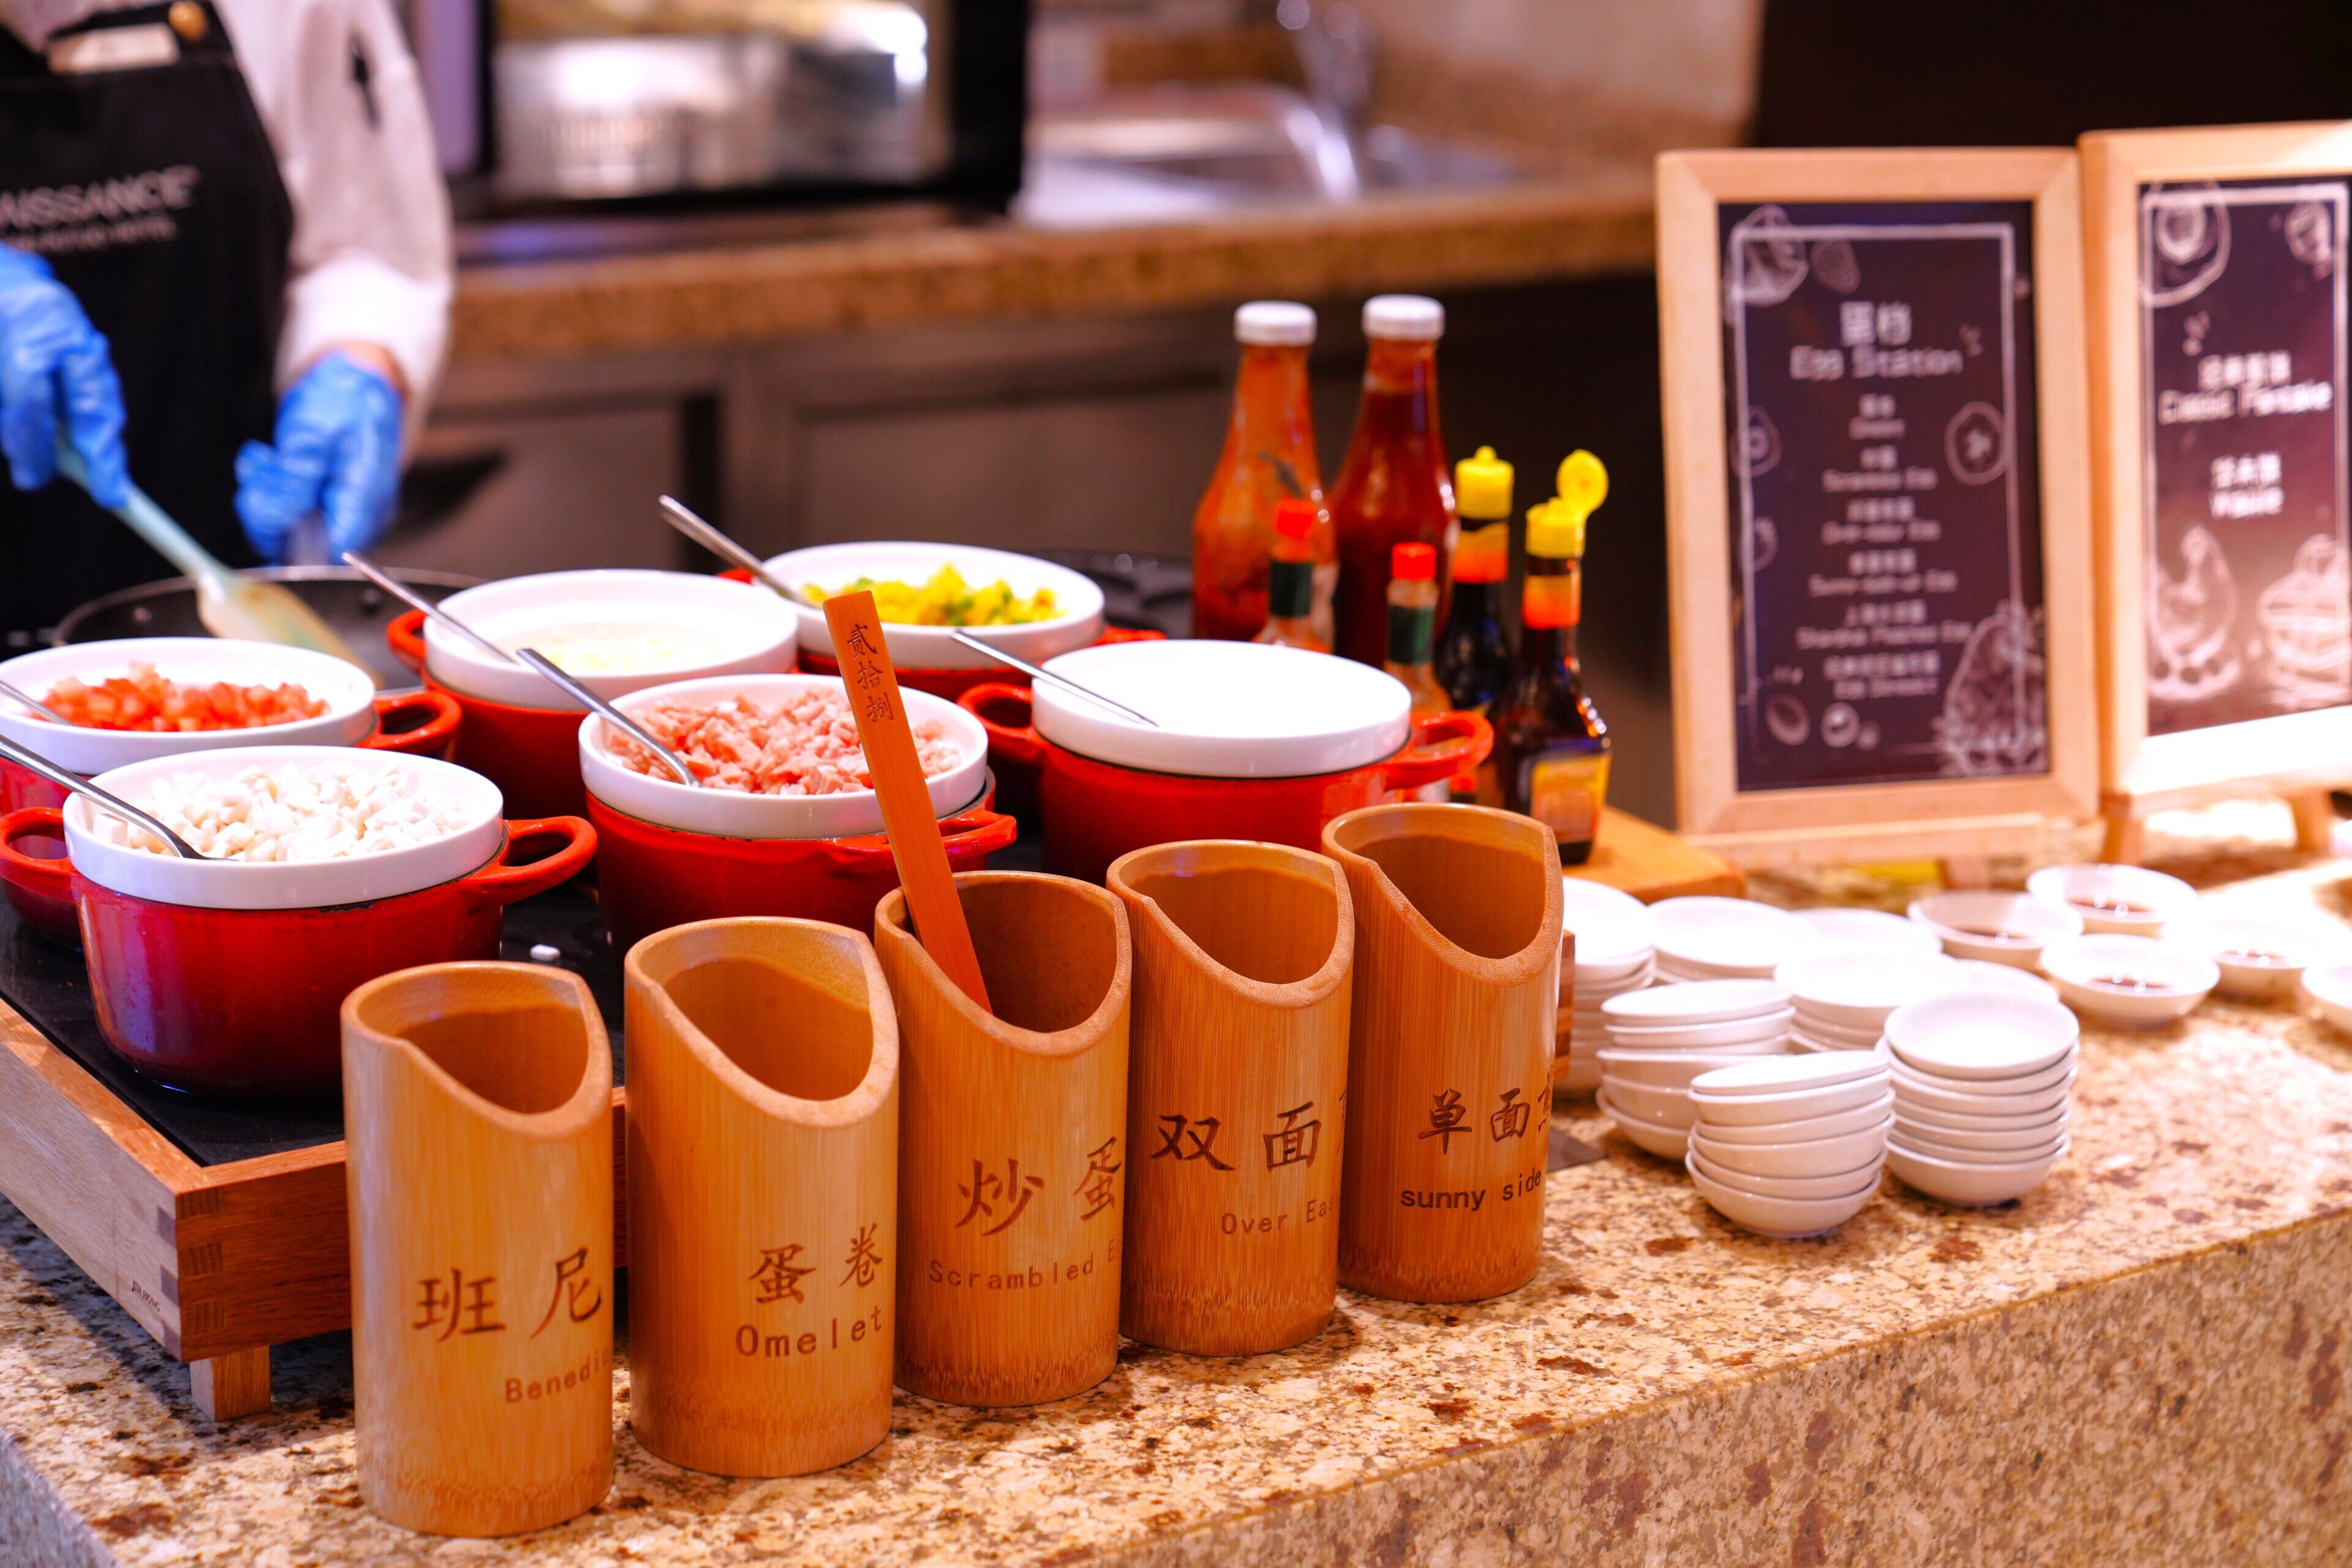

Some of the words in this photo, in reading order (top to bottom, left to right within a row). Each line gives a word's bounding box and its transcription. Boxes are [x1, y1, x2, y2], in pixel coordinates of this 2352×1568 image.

[1150, 1088, 1347, 1172] 双面
[954, 1136, 1122, 1237] 炒蛋
[1400, 1189, 1486, 1212] sunny
[1502, 1167, 1542, 1201] side
[1221, 1212, 1287, 1235] Over
[412, 1246, 603, 1344] 班尼
[748, 1223, 883, 1304] 蛋卷
[929, 1251, 1094, 1290] Scrambled
[736, 1305, 882, 1357] Omelet
